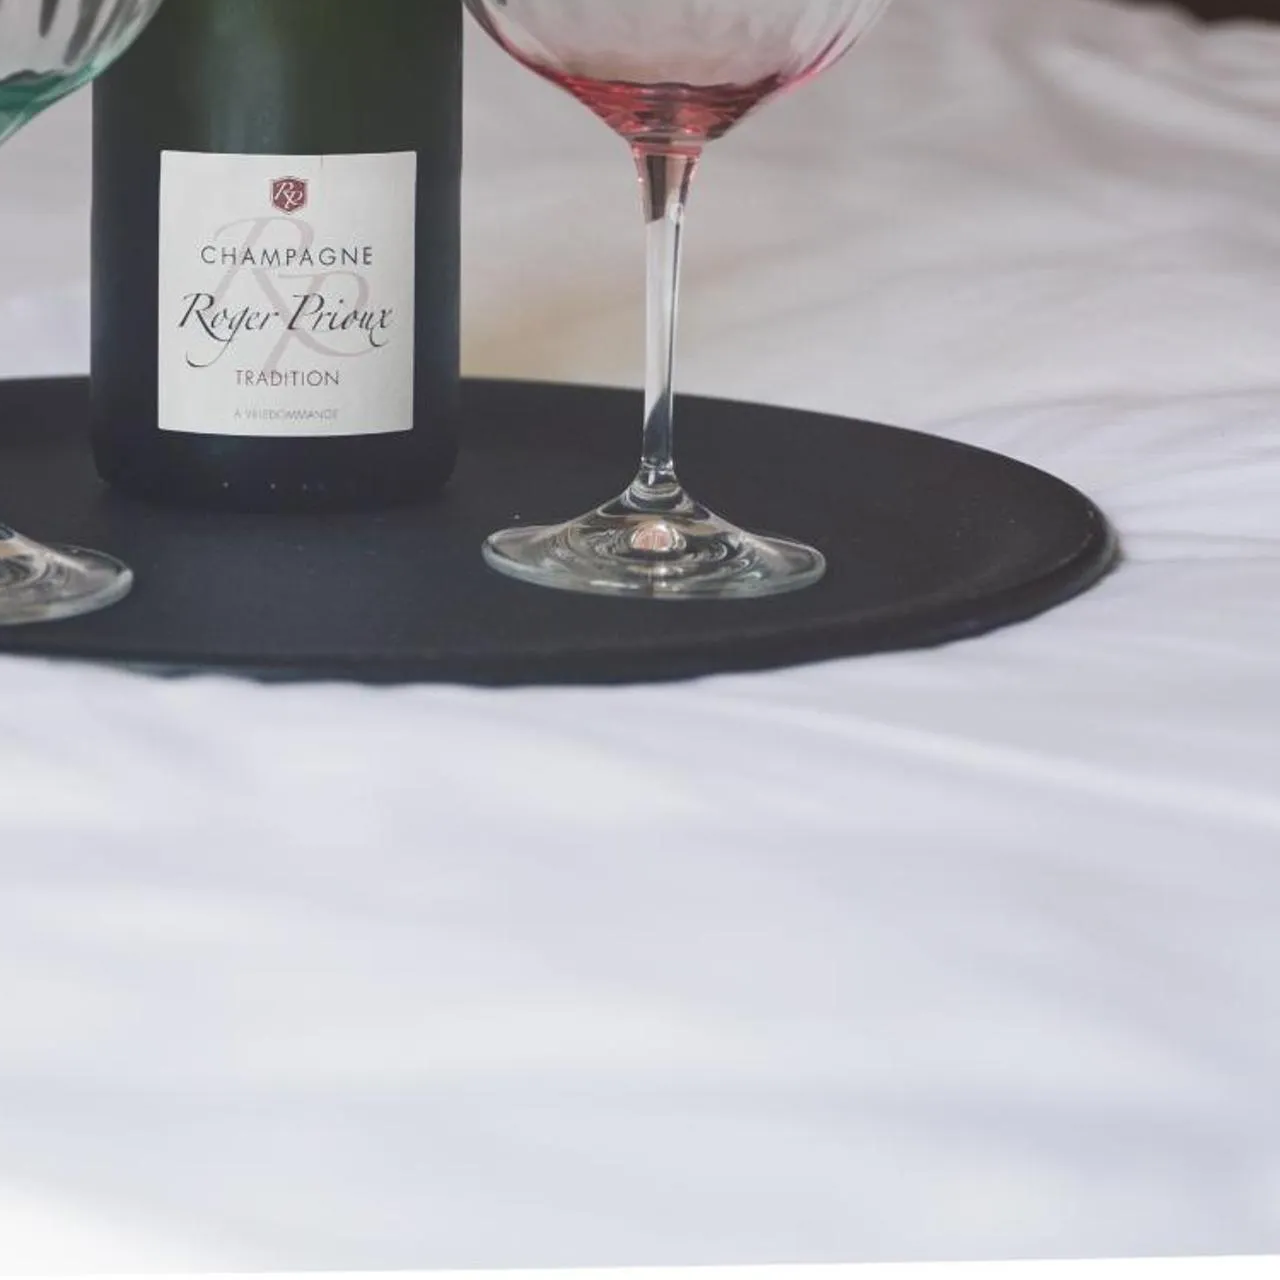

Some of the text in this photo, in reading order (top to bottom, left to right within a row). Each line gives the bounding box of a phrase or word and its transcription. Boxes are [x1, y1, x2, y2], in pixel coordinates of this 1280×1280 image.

[200, 245, 373, 266] CHAMPAGNE
[178, 292, 394, 368] Roger Prioux
[235, 370, 340, 387] TRADITION
